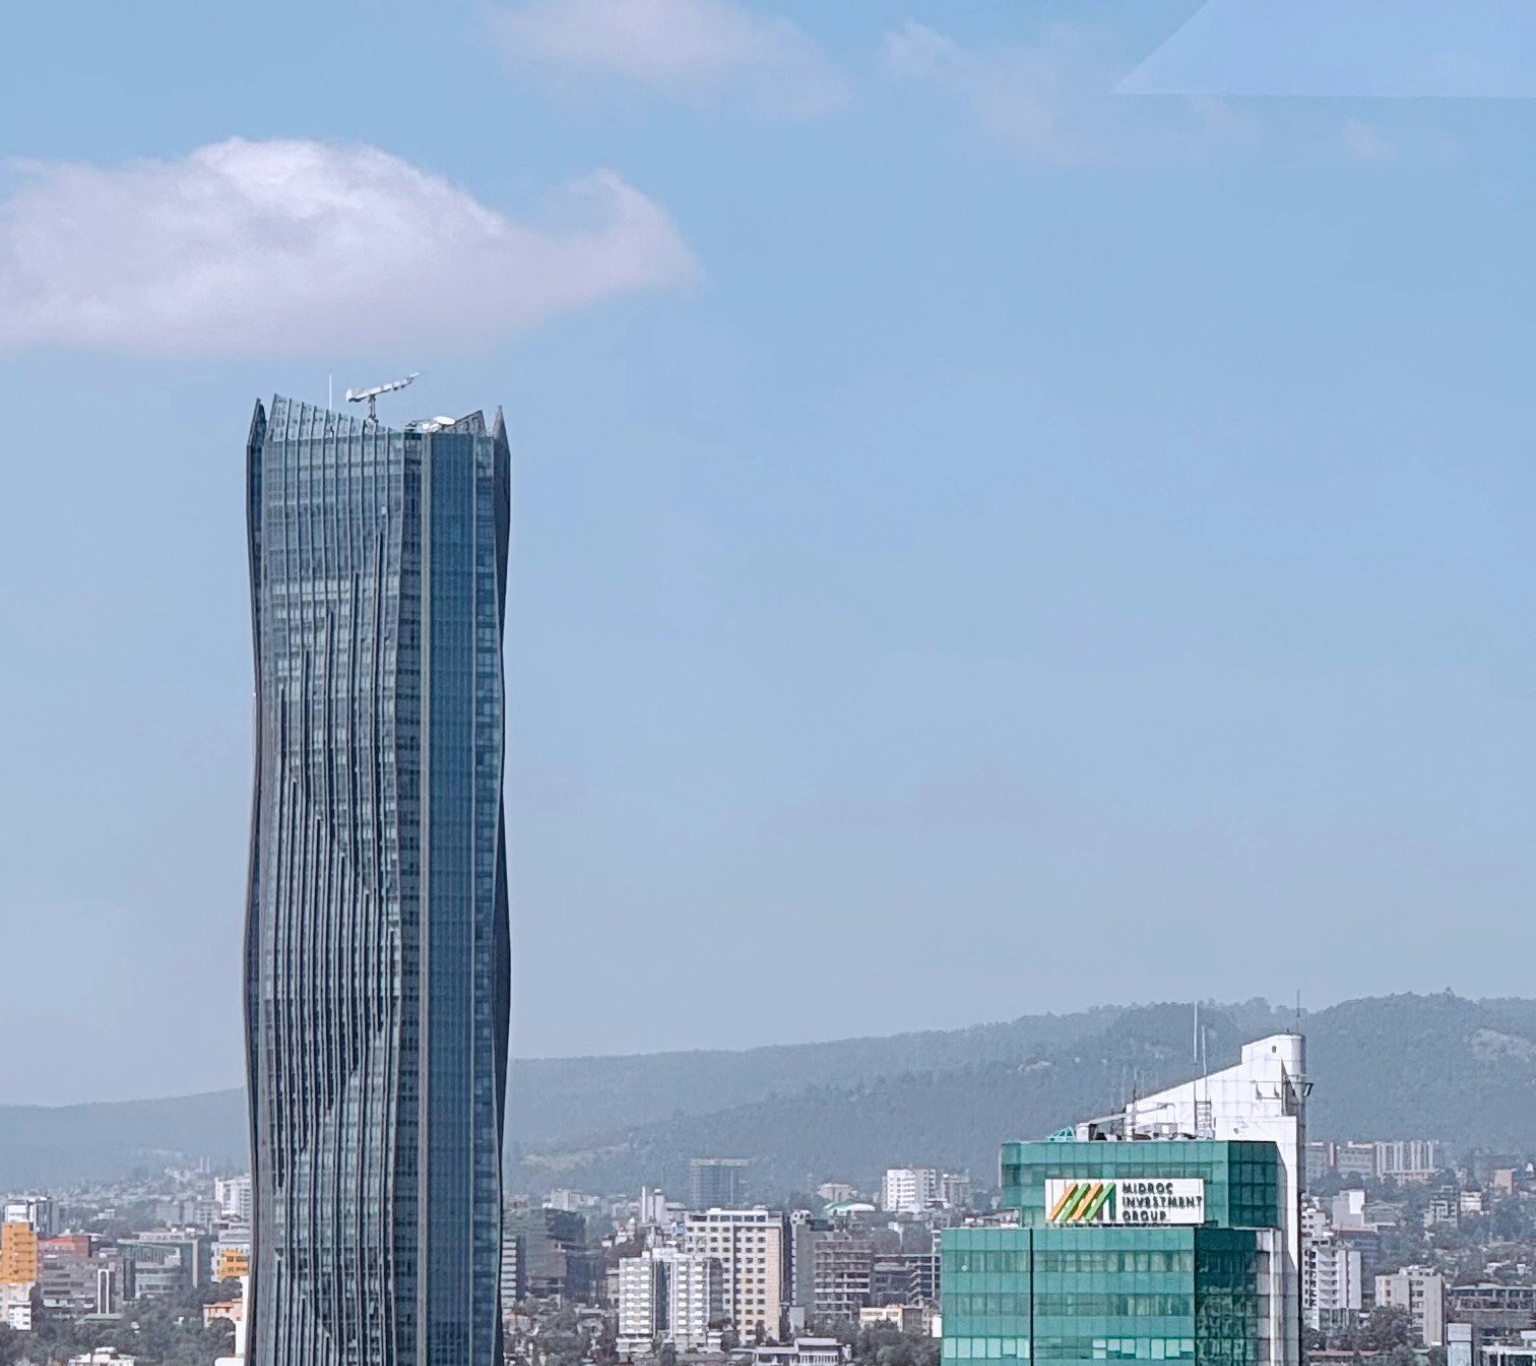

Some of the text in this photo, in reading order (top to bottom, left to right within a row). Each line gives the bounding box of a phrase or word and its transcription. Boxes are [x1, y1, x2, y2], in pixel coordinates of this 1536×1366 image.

[1122, 1182, 1173, 1195] MIDROC
[1122, 1196, 1202, 1208] INVESTMENT
[1122, 1210, 1166, 1221] GROUP
